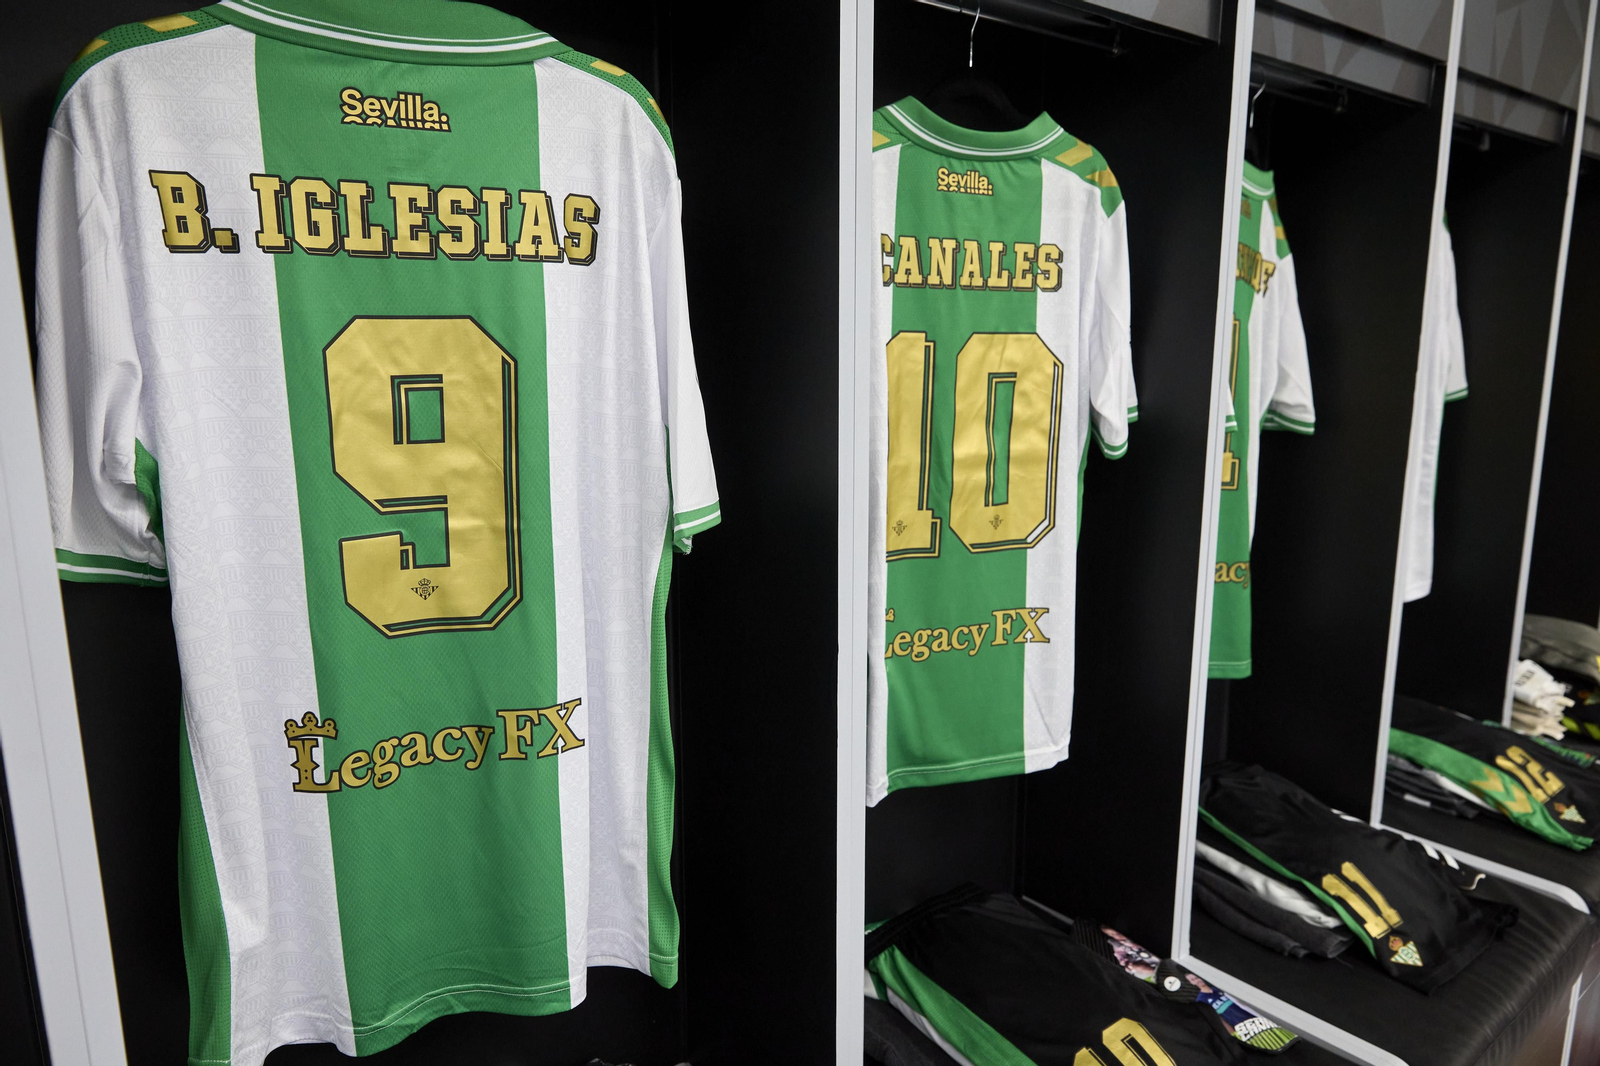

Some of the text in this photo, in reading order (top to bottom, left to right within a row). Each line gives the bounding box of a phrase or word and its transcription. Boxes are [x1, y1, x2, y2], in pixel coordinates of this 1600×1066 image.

[339, 86, 451, 131] Sevilla.
[148, 169, 601, 266] B. IGLESIAS
[937, 167, 994, 196] Sevilla.
[322, 315, 523, 639] 9
[886, 330, 1064, 563] 10
[1322, 861, 1404, 940] 11
